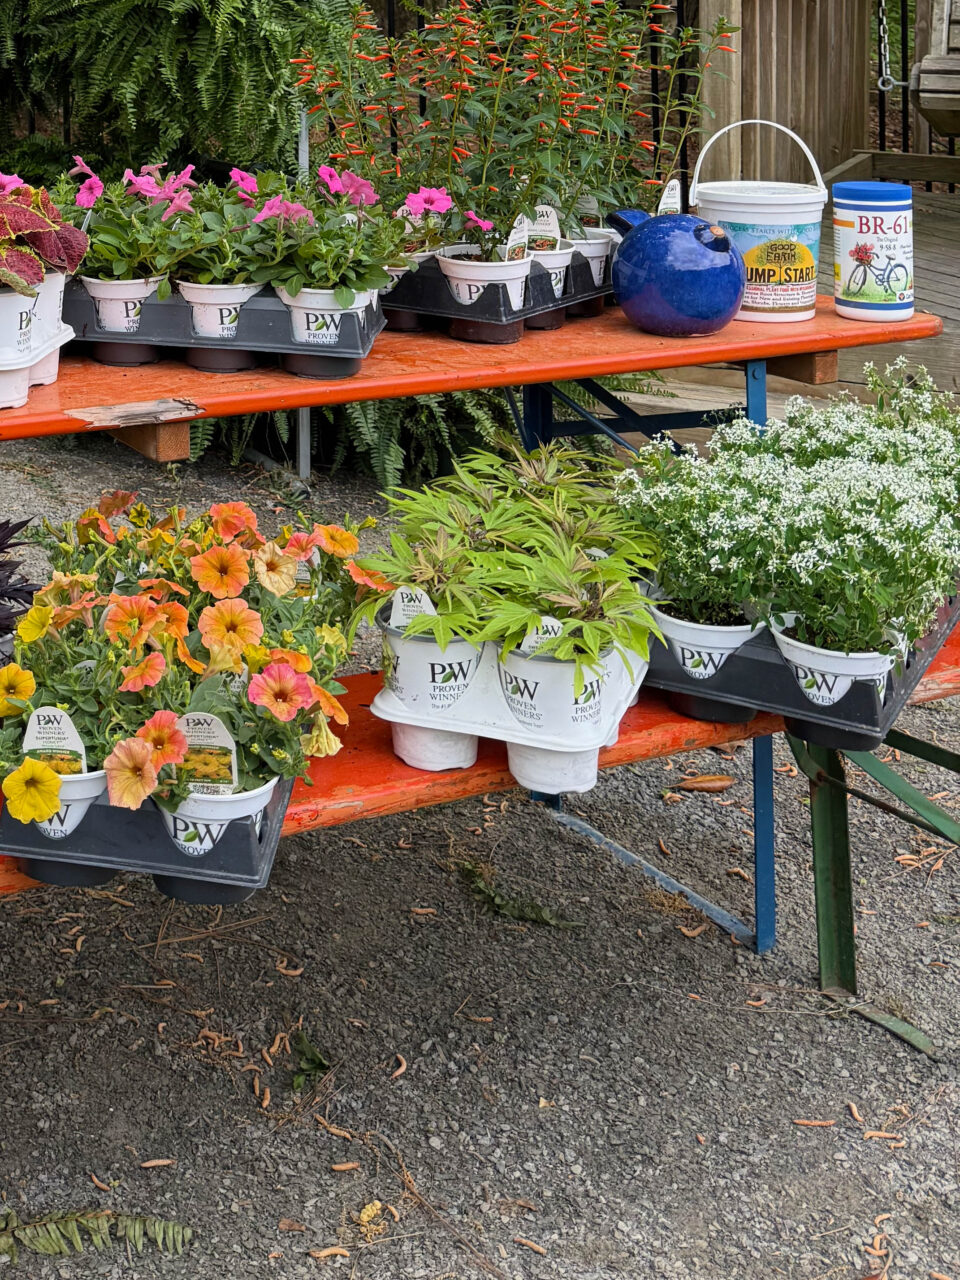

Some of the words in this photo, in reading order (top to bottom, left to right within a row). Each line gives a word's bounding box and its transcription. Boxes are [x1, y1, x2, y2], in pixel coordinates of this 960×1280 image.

[857, 215, 908, 234] BR-61
[766, 251, 796, 261] EARTH
[769, 243, 796, 252] GOOD
[746, 267, 776, 283] UMP
[784, 265, 814, 283] START
[304, 312, 343, 331] PW
[401, 592, 423, 604] PW
[679, 646, 726, 671] PW
[428, 659, 472, 683] PW
[433, 683, 469, 693] PROVEN
[503, 669, 540, 701] PW
[36, 714, 64, 726] PW
[186, 718, 214, 727] PW
[47, 804, 72, 826] W
[171, 814, 226, 846] PW
